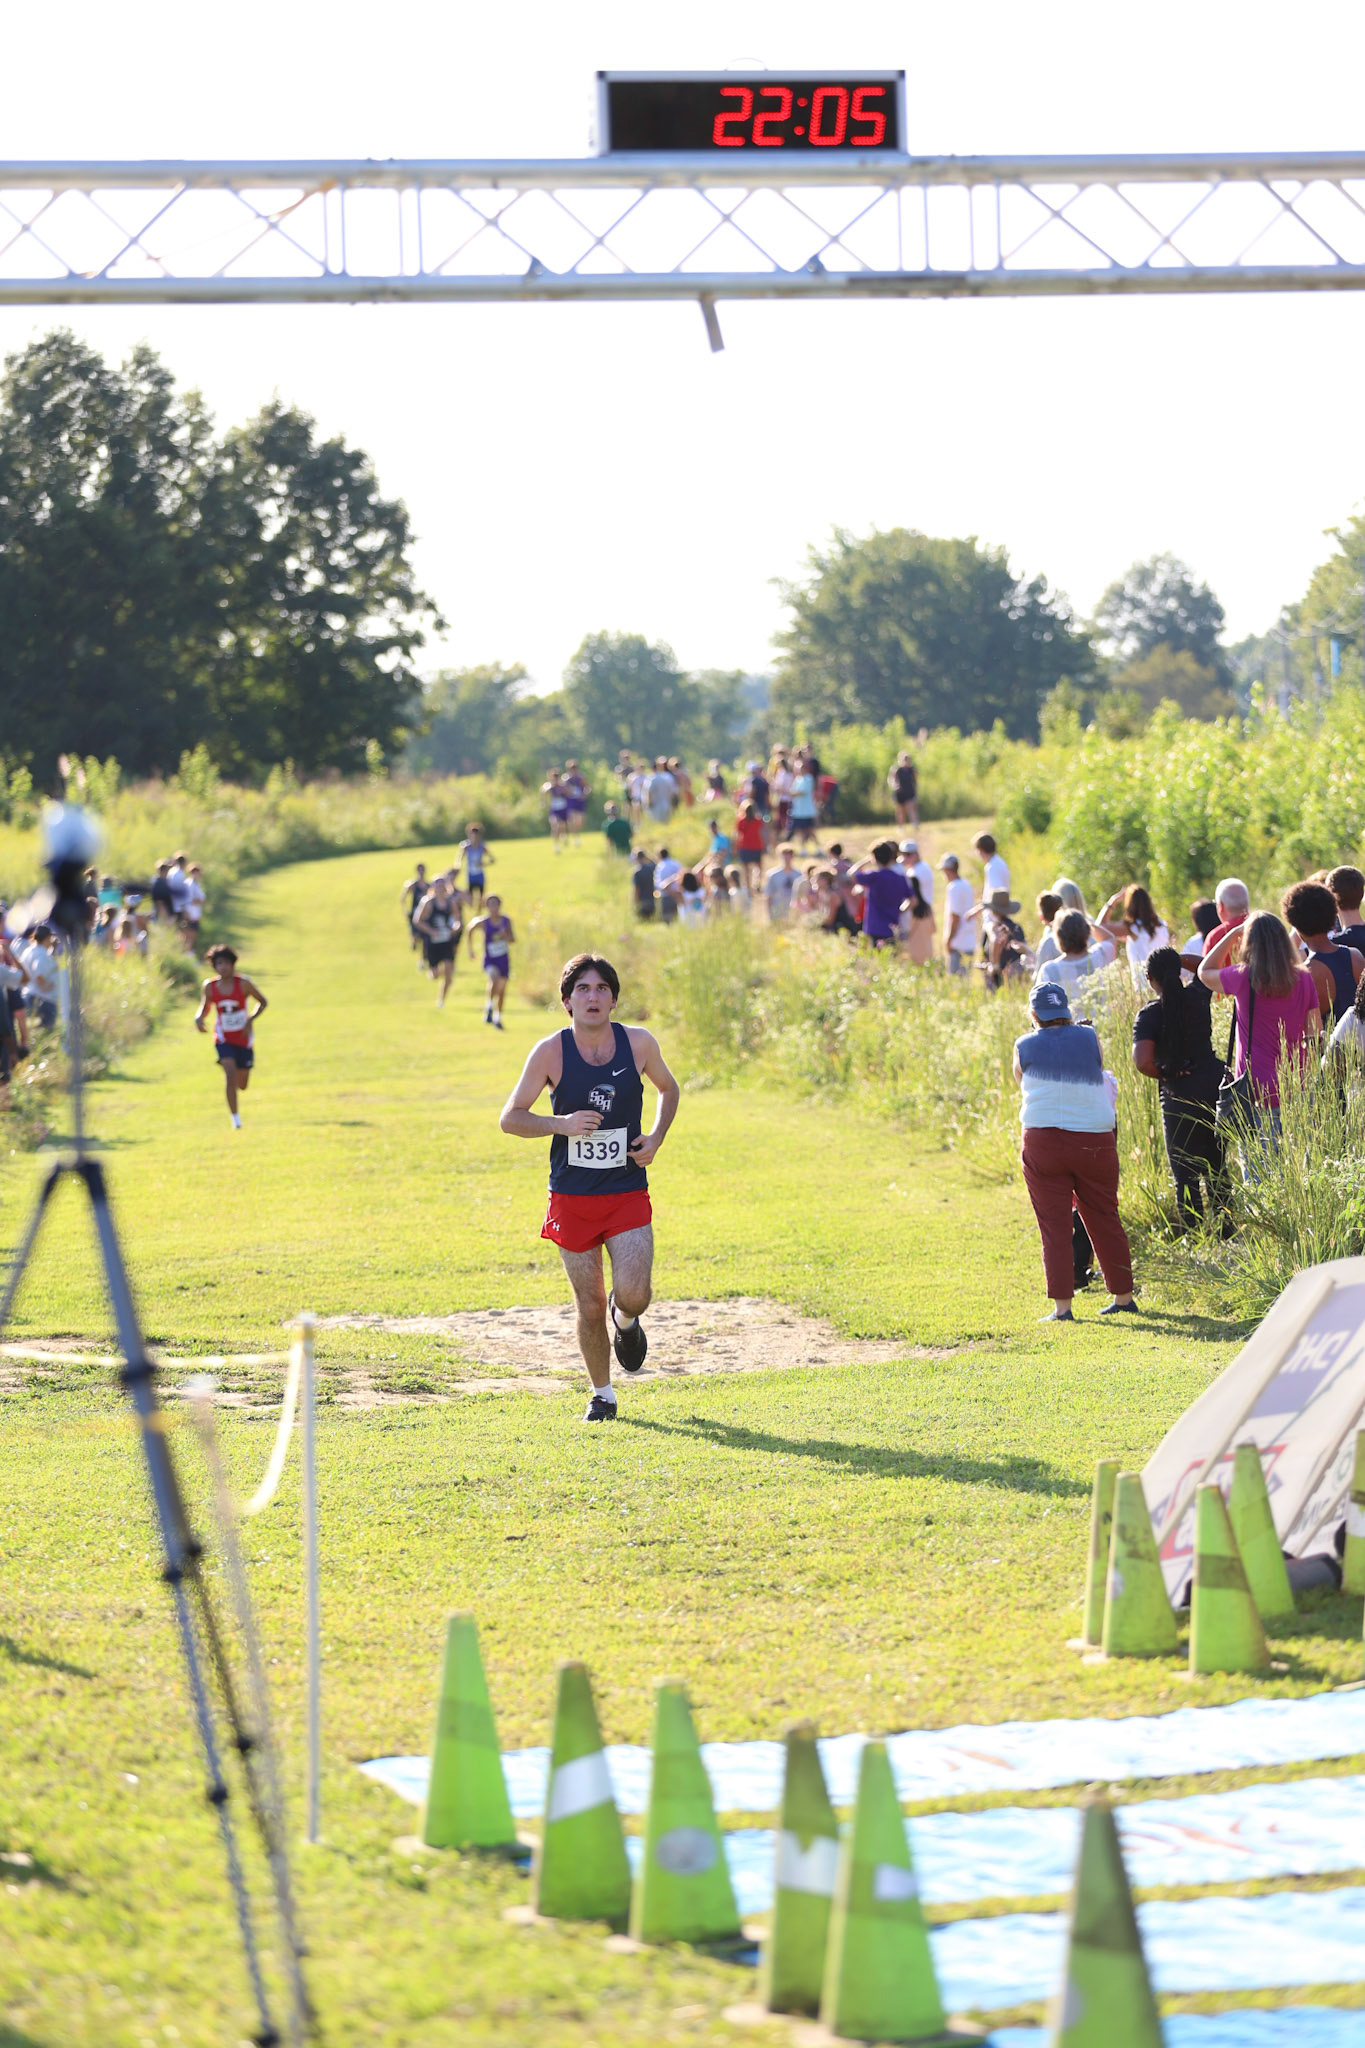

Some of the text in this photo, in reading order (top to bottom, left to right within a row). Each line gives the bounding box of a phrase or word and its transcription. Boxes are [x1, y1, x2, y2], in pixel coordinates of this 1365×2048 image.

[713, 86, 886, 146] 22:05
[589, 1091, 611, 1110] SBA
[575, 1141, 620, 1160] 1339
